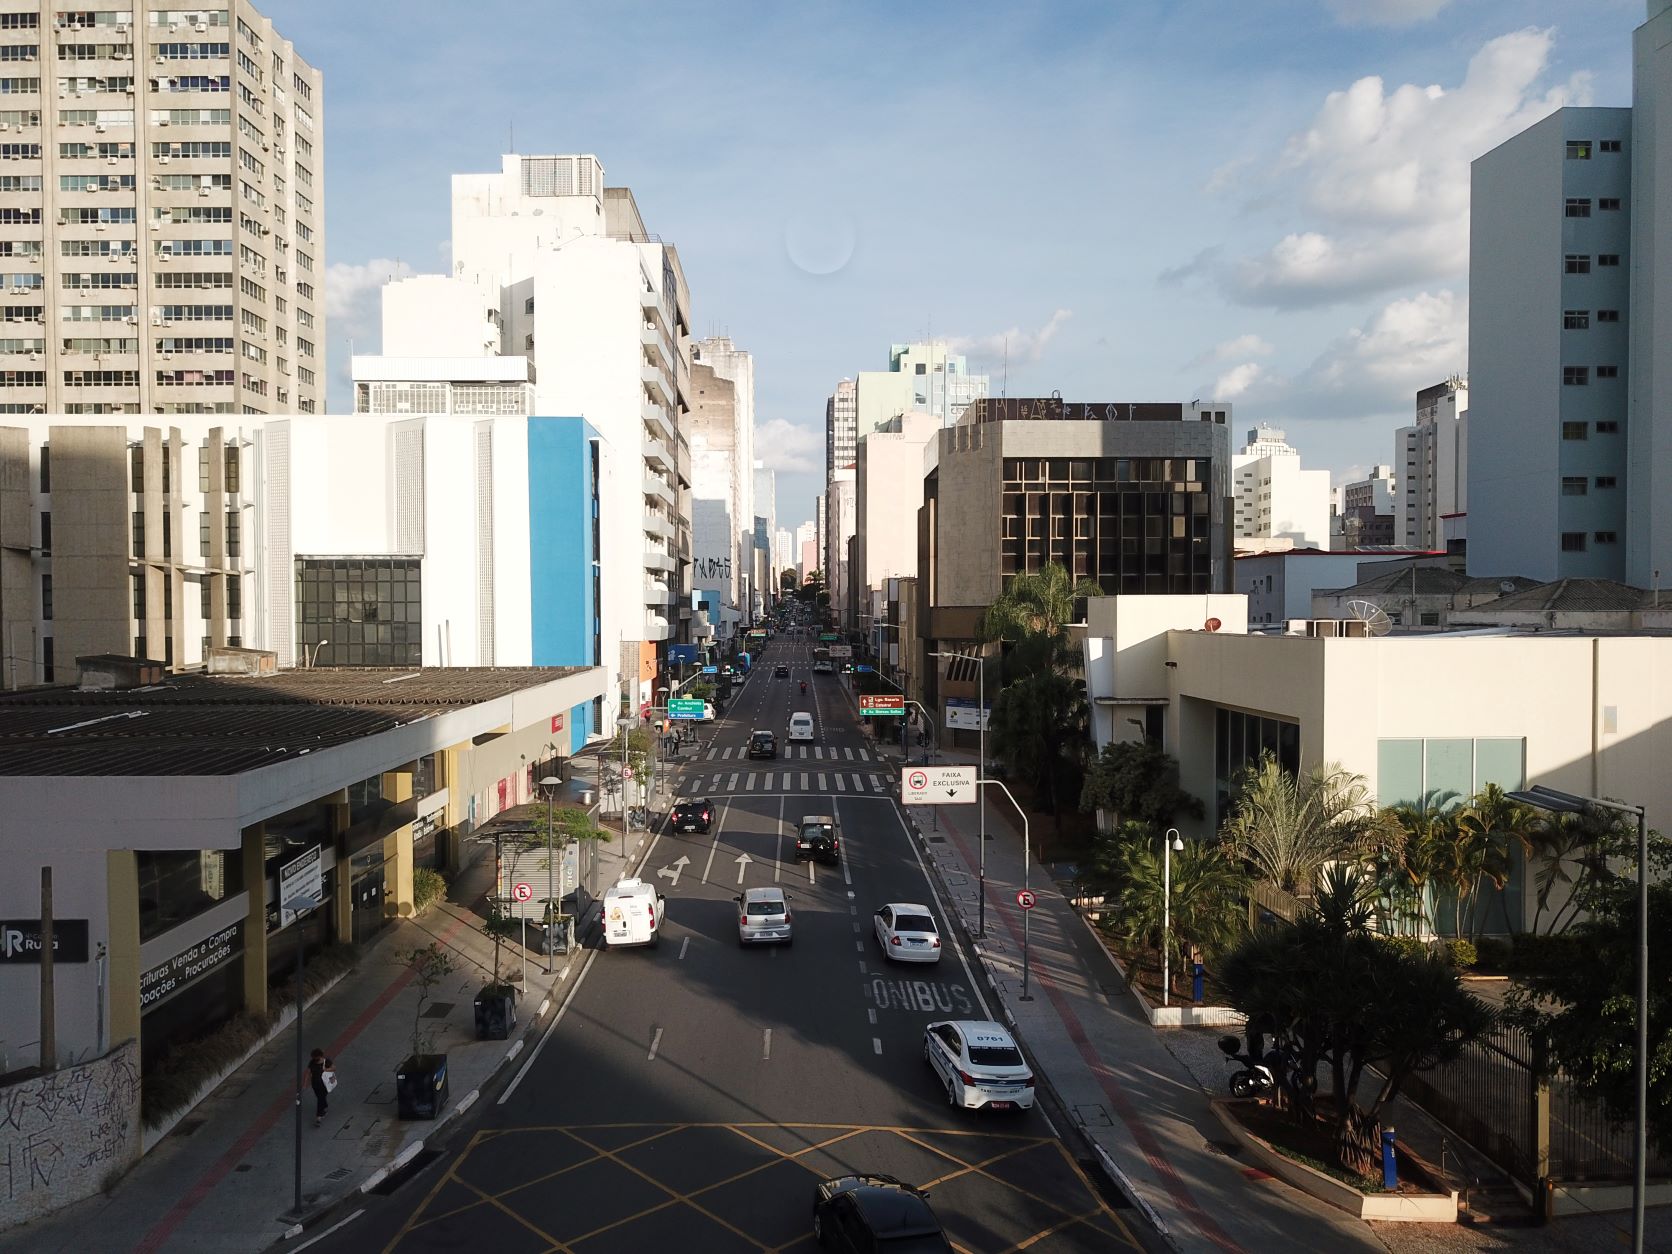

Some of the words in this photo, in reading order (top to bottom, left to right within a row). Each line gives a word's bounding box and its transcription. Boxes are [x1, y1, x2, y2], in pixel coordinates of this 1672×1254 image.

[171, 947, 198, 970] Venda
[200, 944, 206, 954] e
[208, 926, 237, 949] Compra
[185, 944, 231, 979] Procurações
[870, 972, 973, 1014] ÔNIBUS
